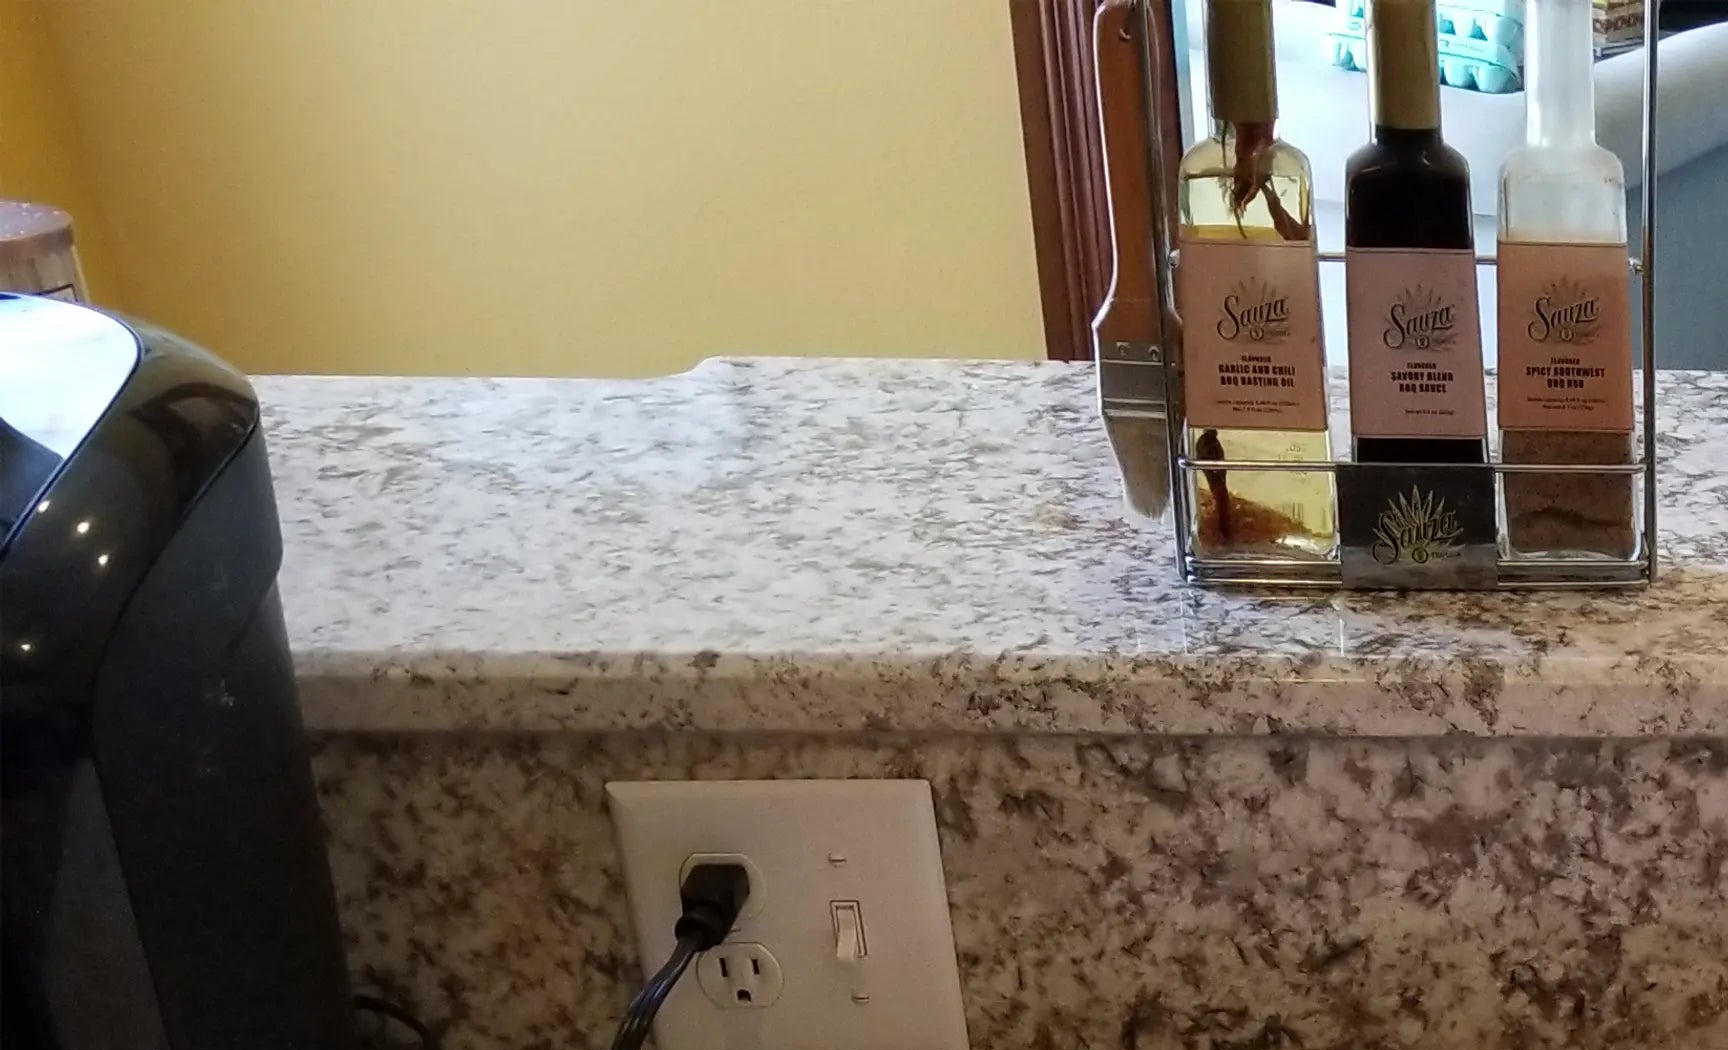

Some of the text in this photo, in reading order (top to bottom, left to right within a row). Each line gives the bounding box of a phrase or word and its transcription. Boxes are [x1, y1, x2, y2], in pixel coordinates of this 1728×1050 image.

[1217, 295, 1289, 340] Sauza
[1528, 296, 1599, 342] Sauza
[1383, 303, 1455, 349] Sauza
[1218, 364, 1295, 376] GARLIC AND CHILI
[1391, 371, 1424, 381] SAVORY
[1526, 366, 1605, 378] SPICY SOUTHWEST
[1241, 377, 1278, 387] BASTING
[1281, 378, 1295, 388] OIL
[1419, 384, 1447, 393] SAUCE
[1371, 510, 1457, 565] Sauza
